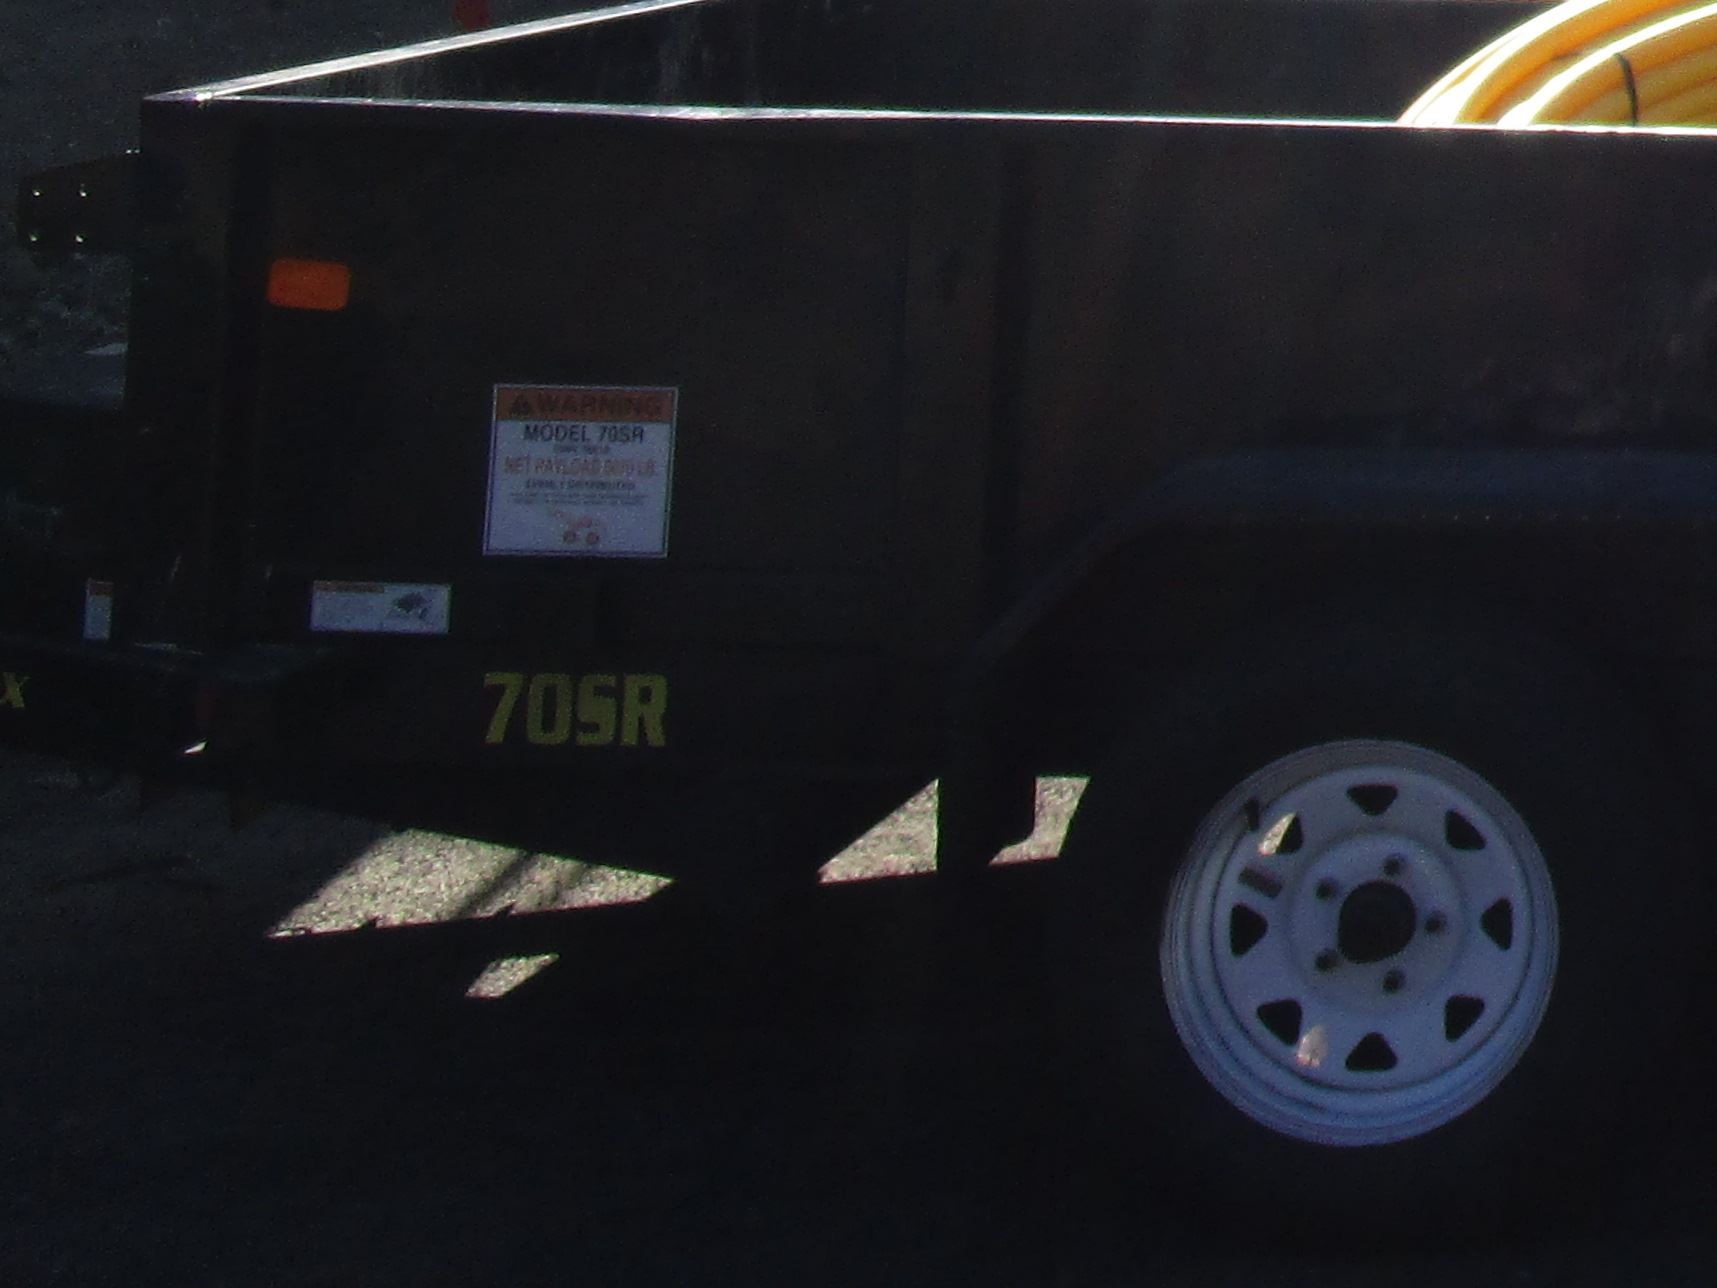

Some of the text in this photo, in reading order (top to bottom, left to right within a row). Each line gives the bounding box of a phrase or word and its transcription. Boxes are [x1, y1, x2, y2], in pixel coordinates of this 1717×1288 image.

[537, 393, 662, 417] WARNING
[523, 424, 645, 444] MODEL 70SR
[484, 671, 669, 748] 70SR
